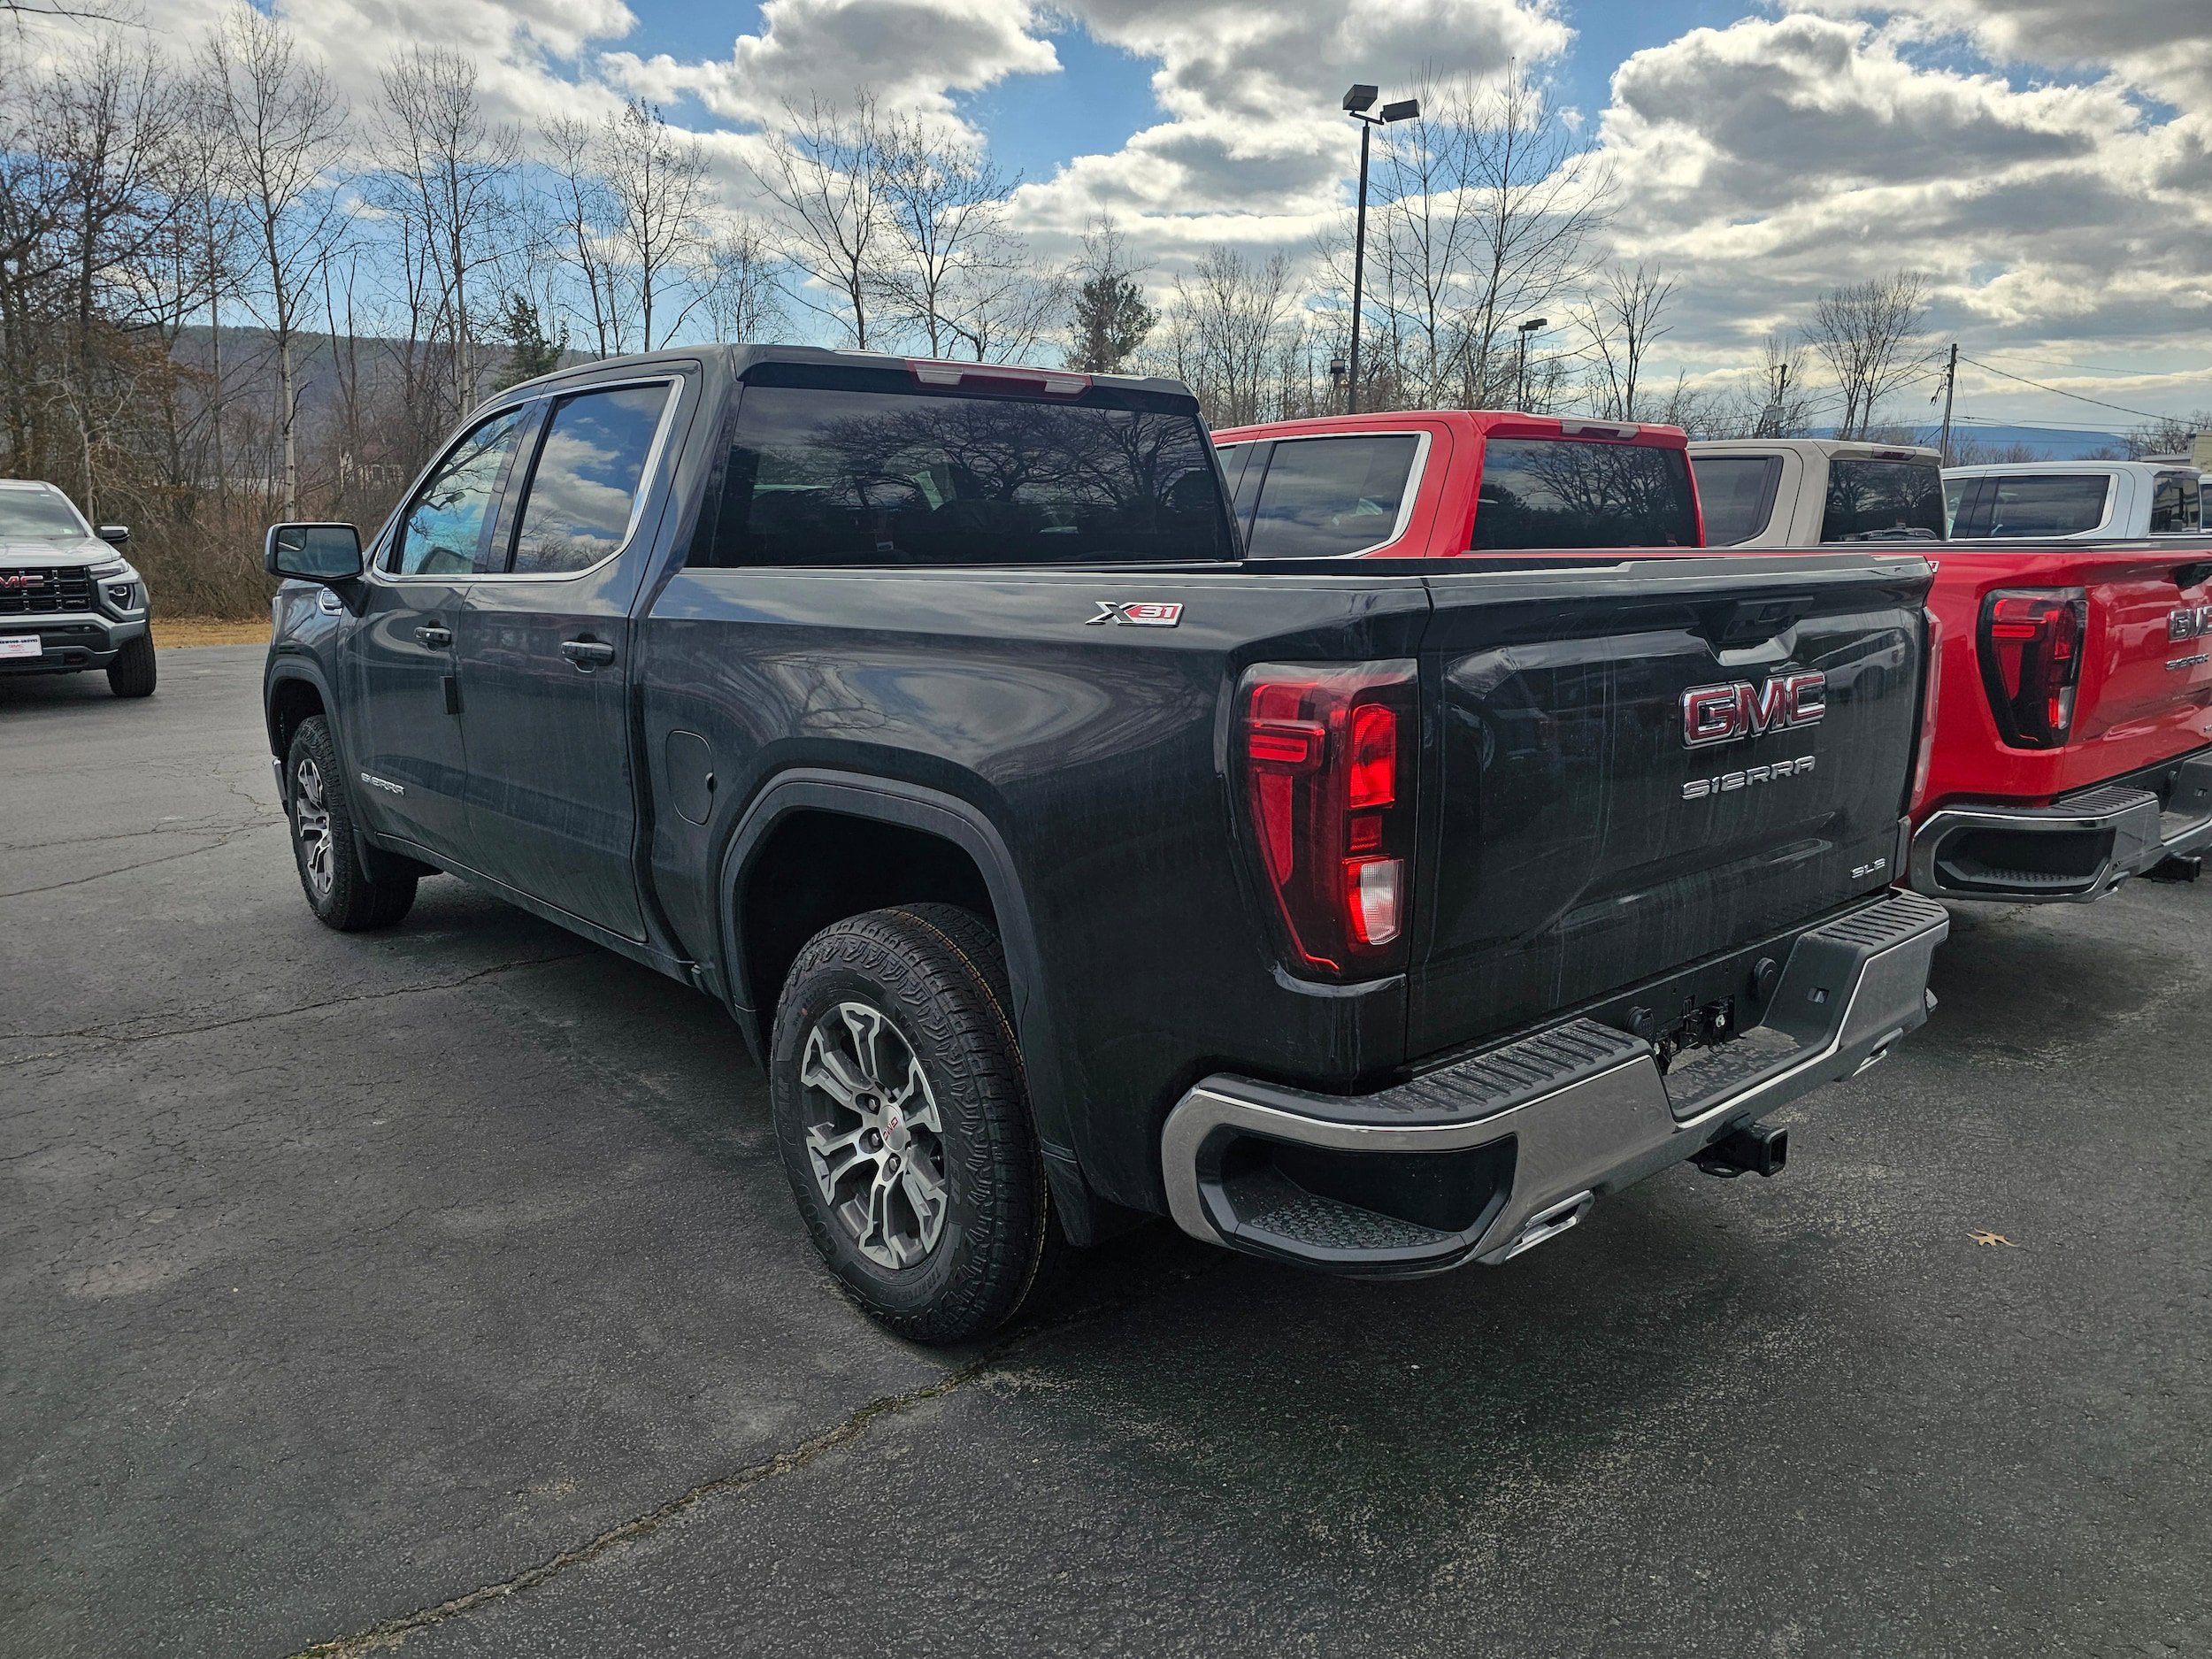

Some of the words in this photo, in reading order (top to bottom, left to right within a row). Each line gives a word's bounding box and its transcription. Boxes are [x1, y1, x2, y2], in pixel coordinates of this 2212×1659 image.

[0, 575, 43, 588] MC
[1085, 602, 1184, 627] X31
[2165, 654, 2209, 670] SIERRA
[1679, 670, 1826, 749] GMC
[360, 772, 405, 796] SIERRA
[1682, 756, 1816, 800] SIERRA
[883, 1117, 899, 1141] GMC
